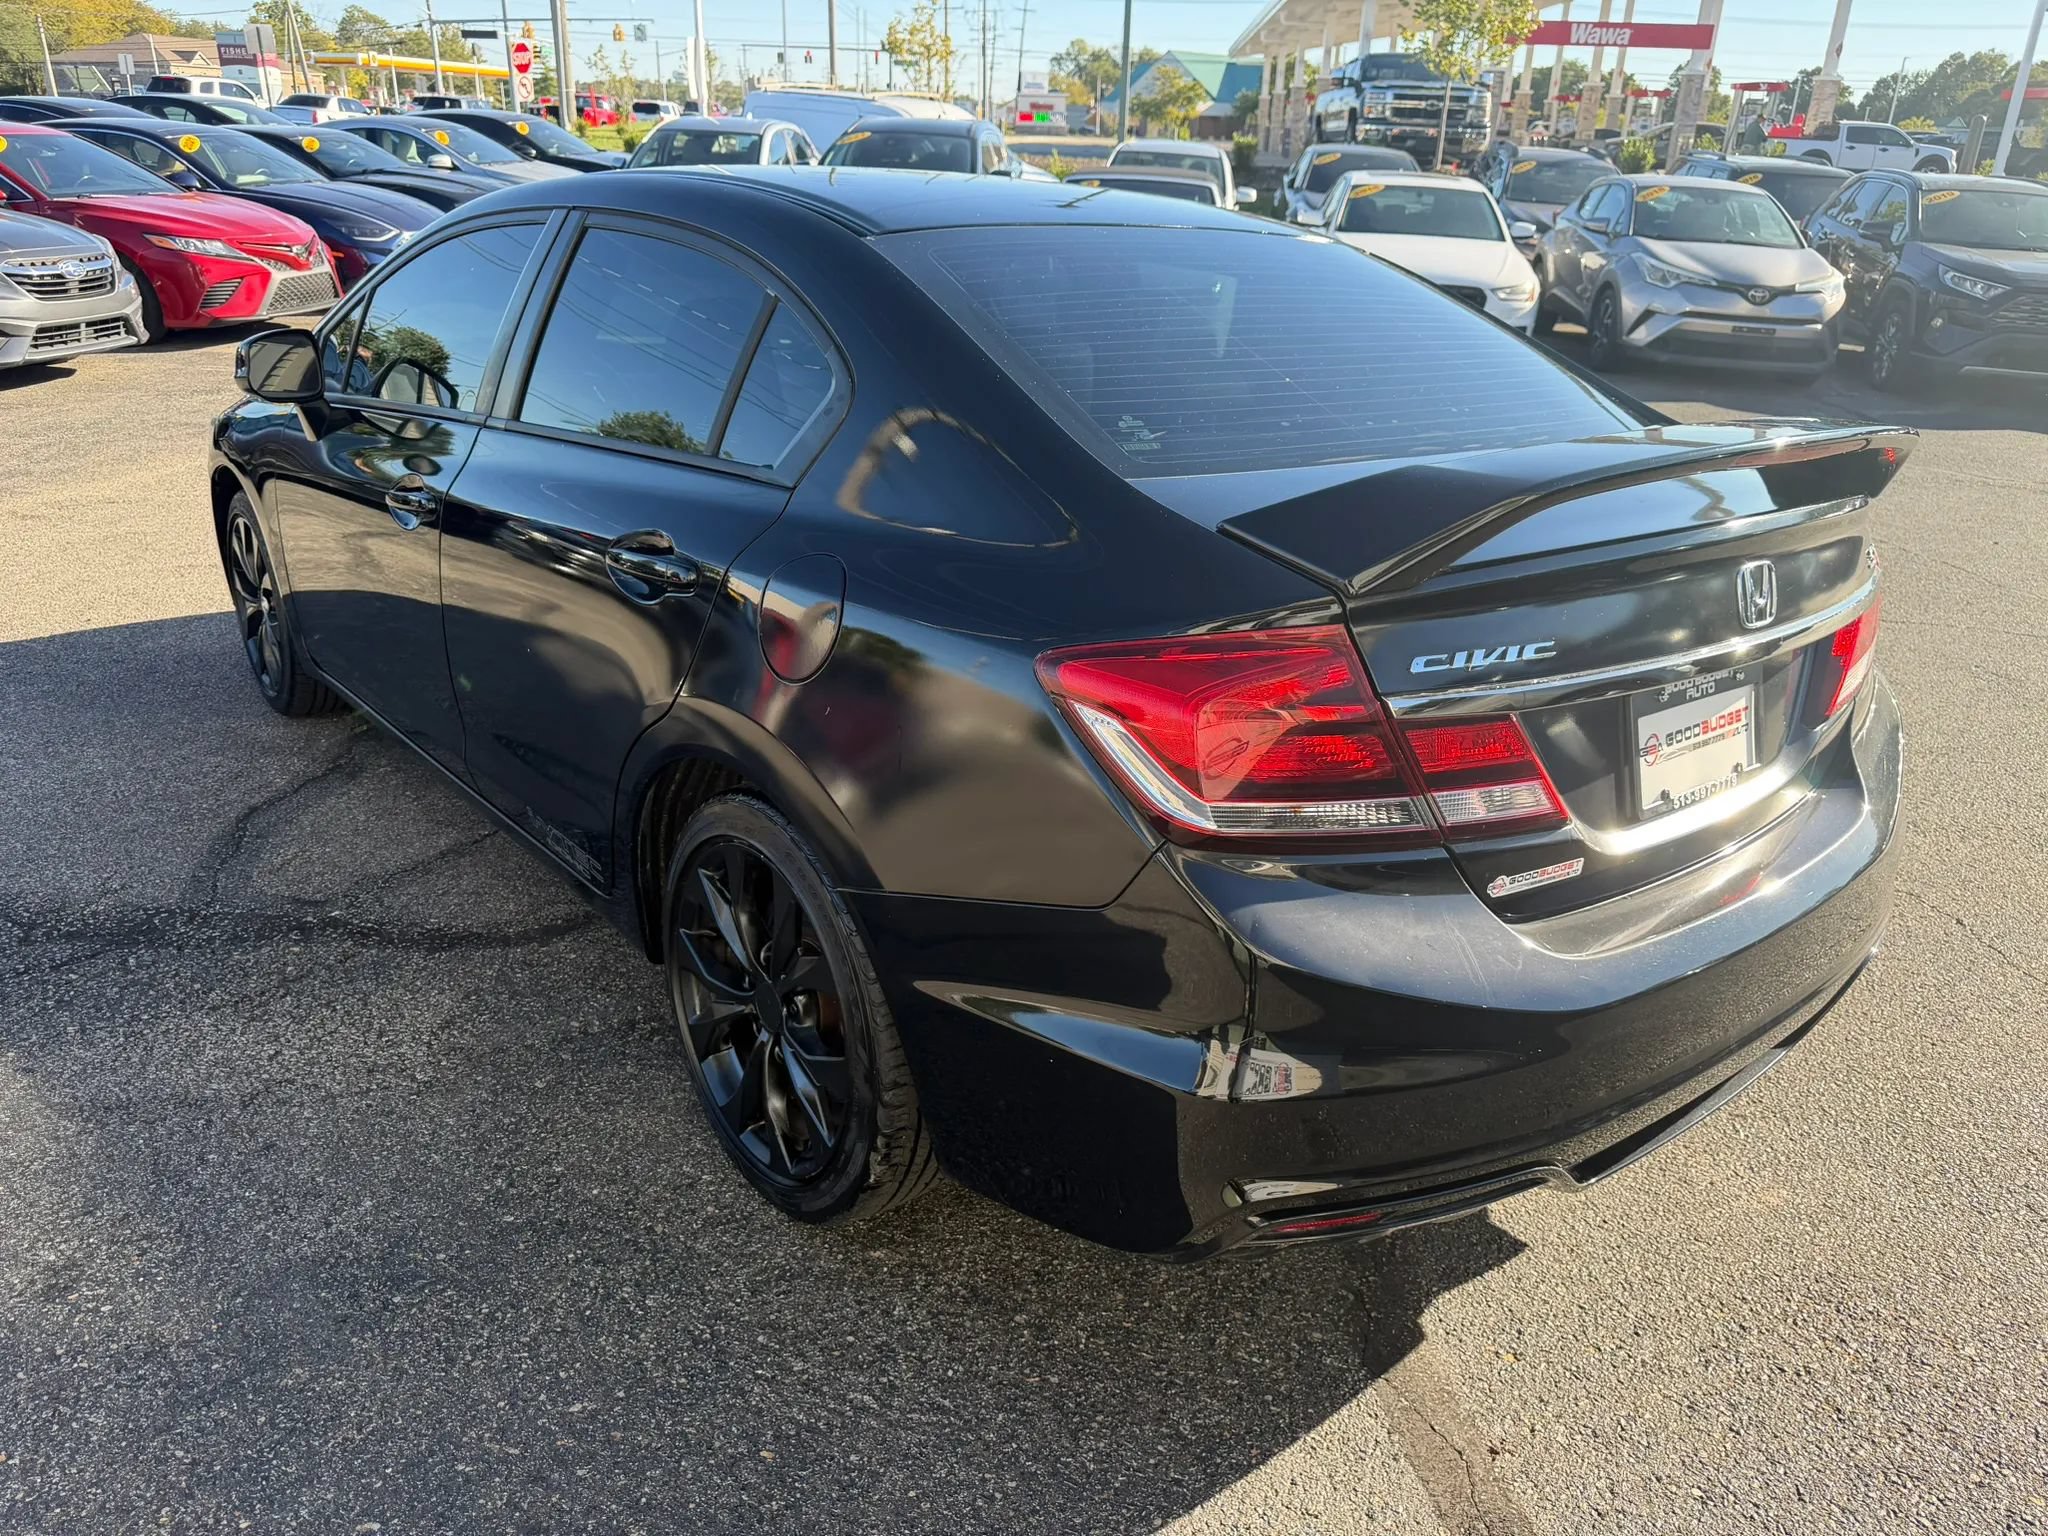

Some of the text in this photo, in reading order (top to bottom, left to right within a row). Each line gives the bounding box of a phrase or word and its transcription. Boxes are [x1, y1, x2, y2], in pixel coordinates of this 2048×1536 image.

[1570, 23, 1632, 45] Wawa
[512, 52, 530, 65] STOP
[1410, 641, 1557, 673] CIVIC
[1687, 683, 1715, 699] AUTO
